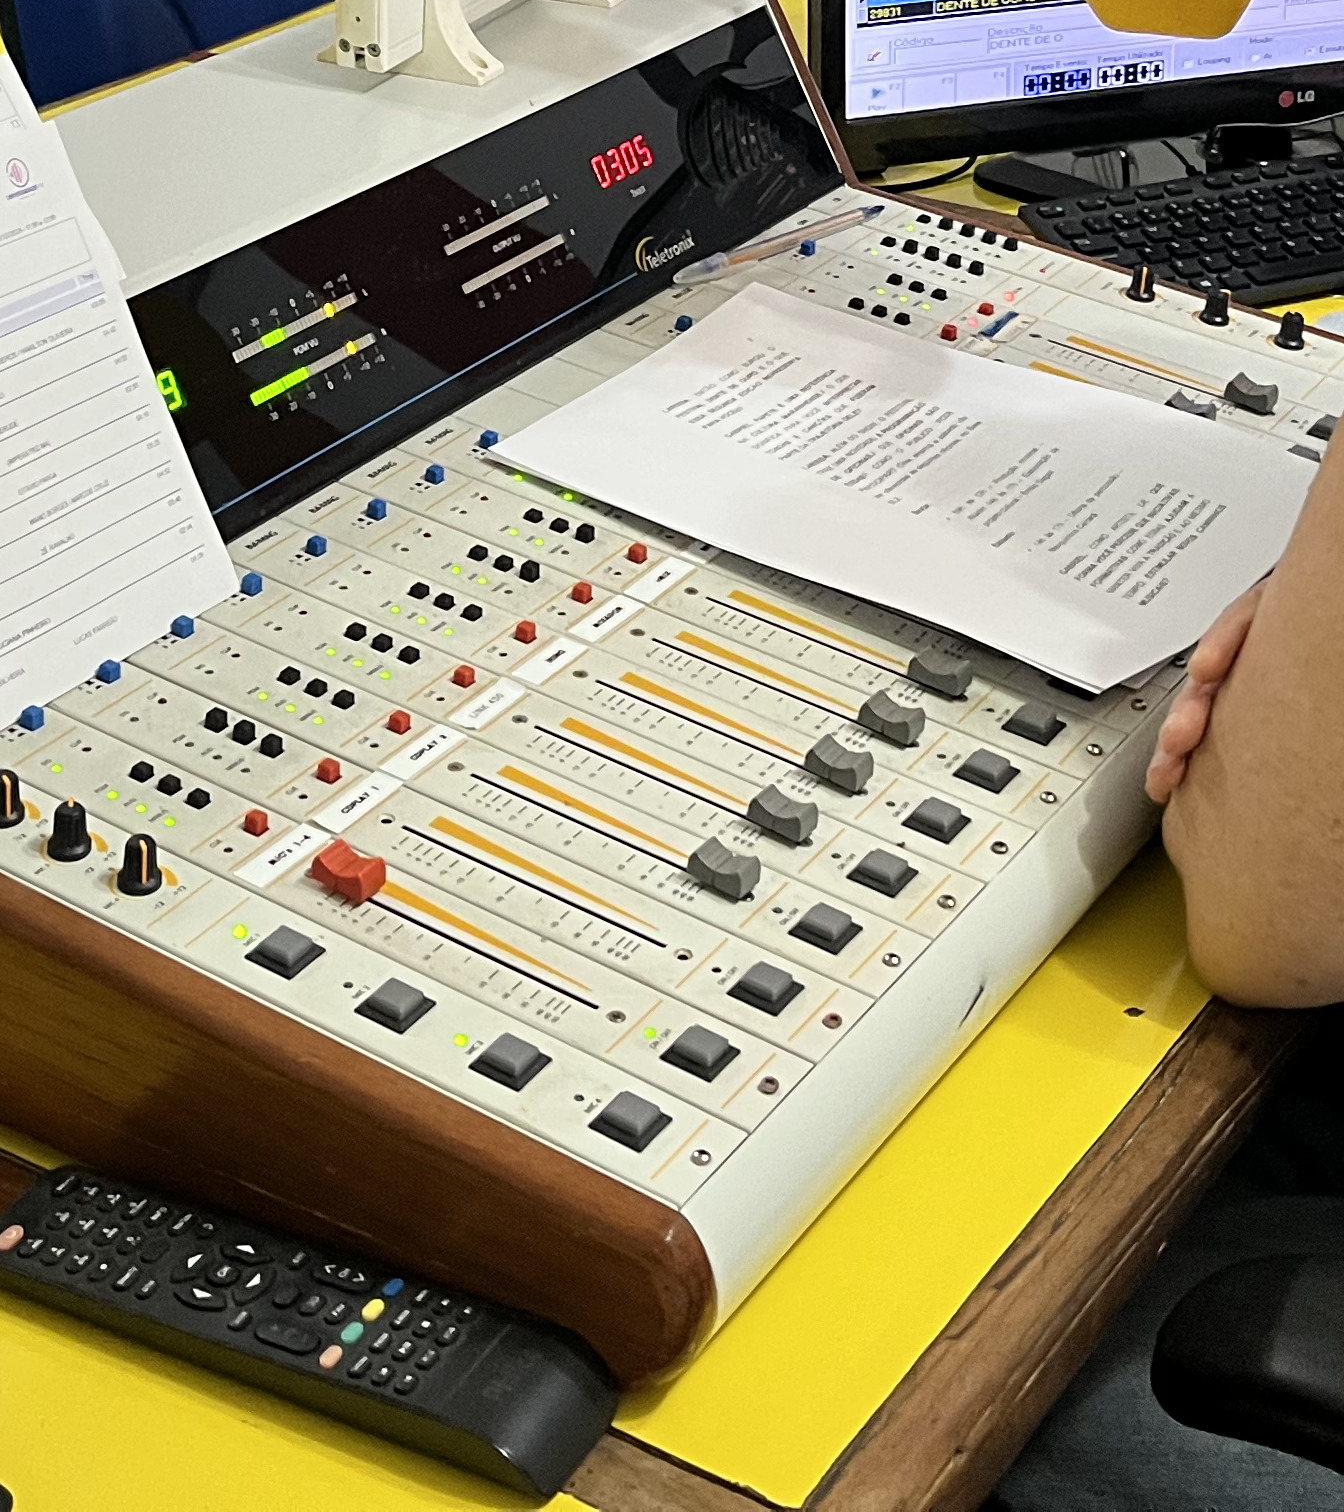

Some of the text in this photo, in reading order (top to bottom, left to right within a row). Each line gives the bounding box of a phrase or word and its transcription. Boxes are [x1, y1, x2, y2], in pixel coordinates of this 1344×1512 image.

[1297, 91, 1314, 103] LG
[591, 134, 653, 189] 0305
[646, 236, 695, 269] Teletronix
